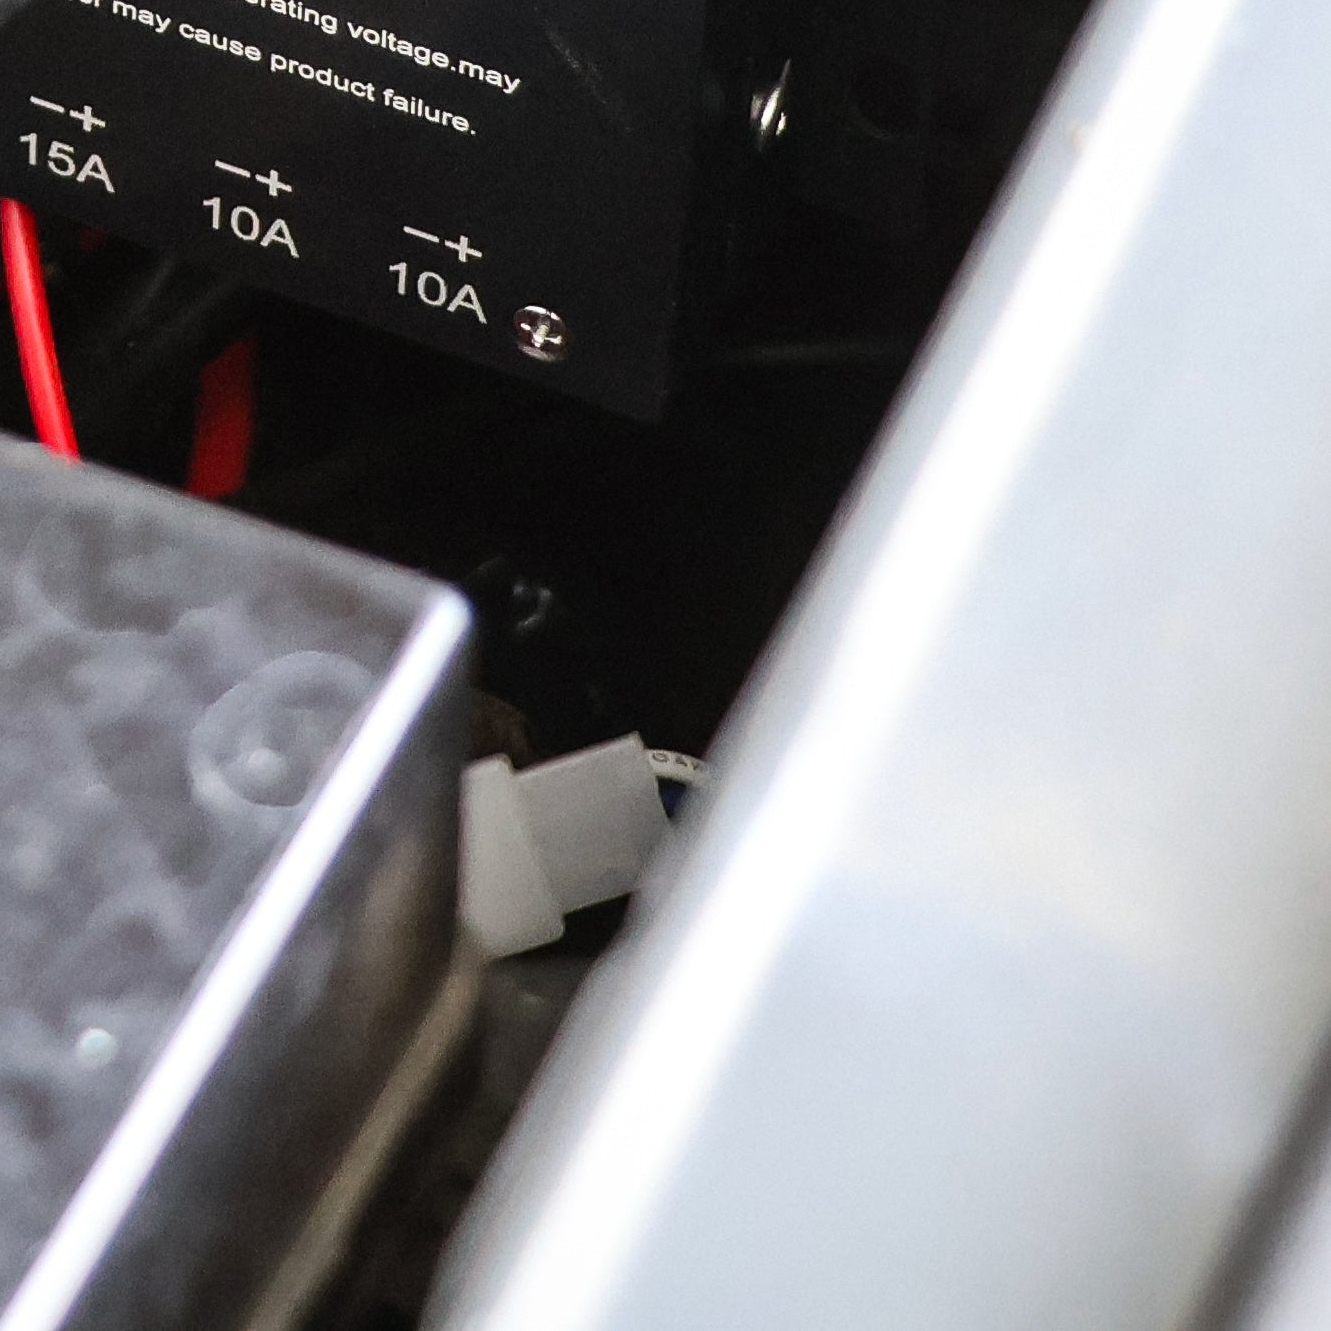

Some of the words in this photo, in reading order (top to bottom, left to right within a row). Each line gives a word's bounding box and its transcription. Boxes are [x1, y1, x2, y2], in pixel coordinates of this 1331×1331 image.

[178, 22, 262, 62] cause
[269, 52, 376, 103] product
[381, 88, 477, 135] failure.
[347, 21, 522, 95] voltage.may
[18, 131, 116, 194] 15A
[202, 195, 300, 260] 10A
[388, 260, 488, 325] 10A
